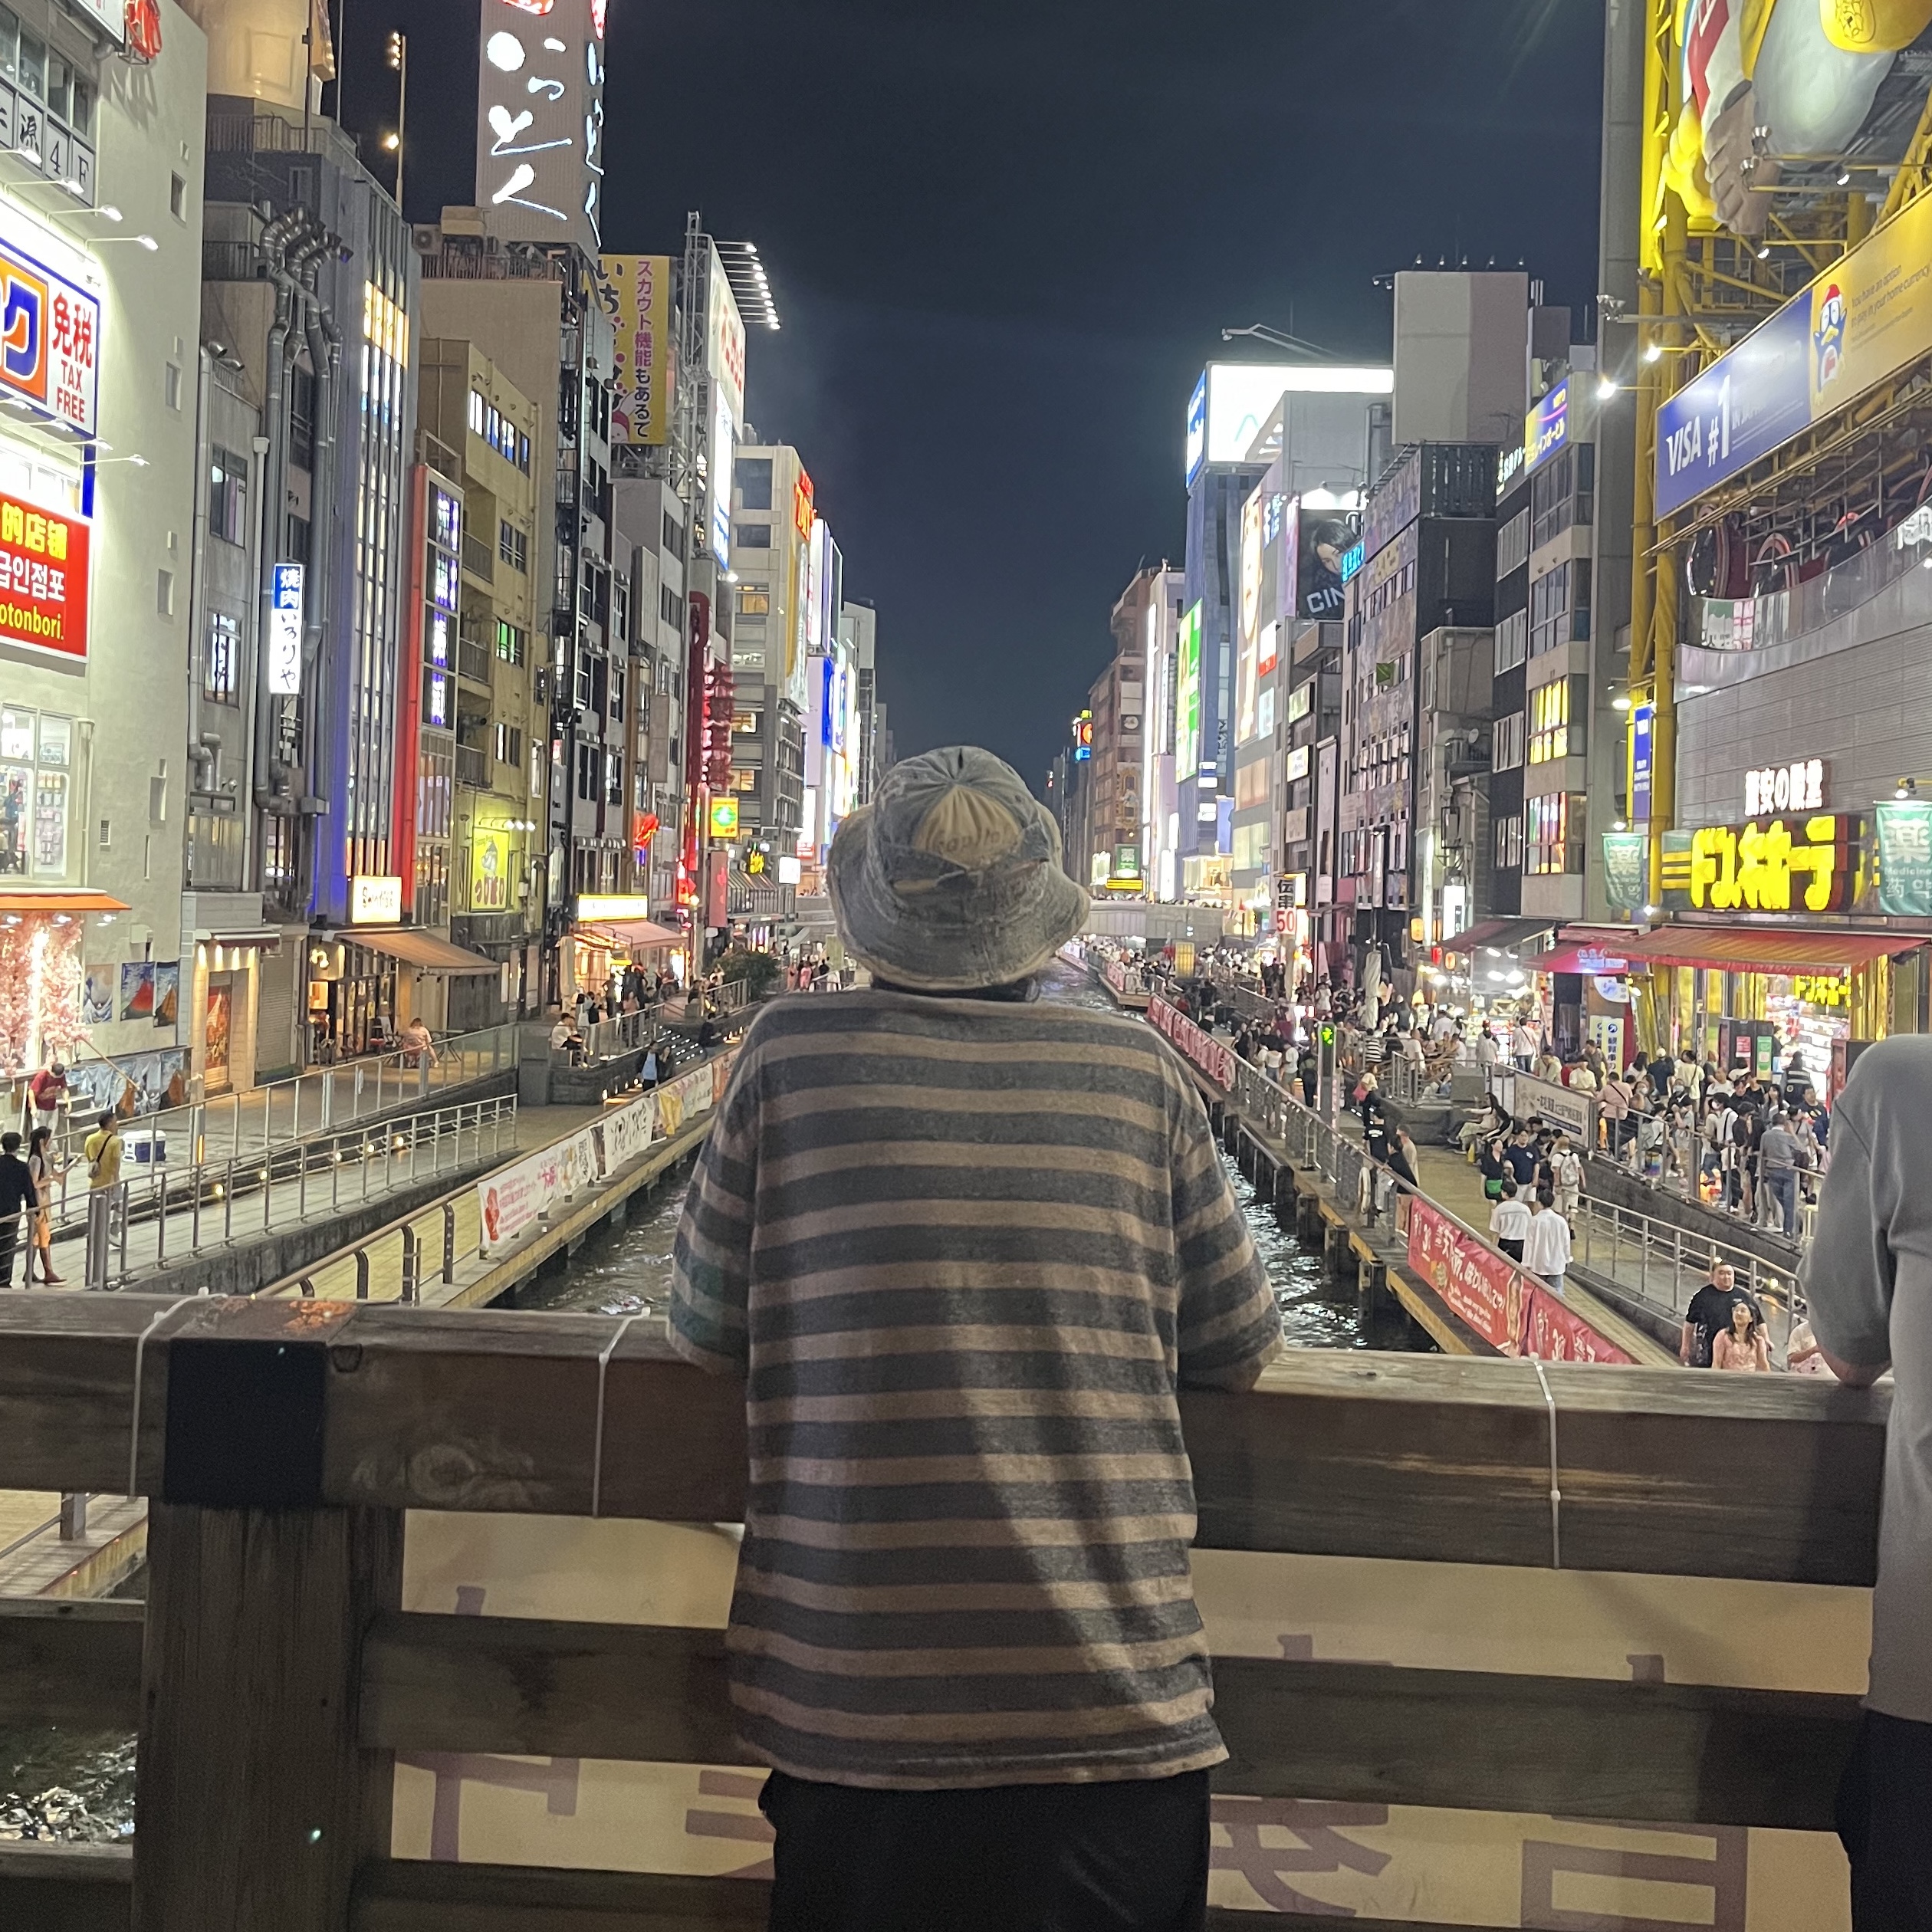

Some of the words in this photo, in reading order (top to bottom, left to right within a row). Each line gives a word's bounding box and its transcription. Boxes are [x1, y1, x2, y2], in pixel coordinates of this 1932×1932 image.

[52, 292, 92, 369] 免税
[633, 260, 652, 438] スカウト機能もあるて
[61, 359, 83, 393] TAX
[57, 386, 85, 423] FREE
[1666, 416, 1701, 476] VISA
[1707, 374, 1730, 468] #1
[280, 567, 301, 609] 焼肉
[280, 613, 297, 690] いろりや
[1609, 845, 1640, 875] 薬
[1884, 818, 1930, 863] 薬
[1884, 866, 1932, 876] Medicine
[1277, 879, 1294, 909] 伝串
[1276, 910, 1295, 932] 50
